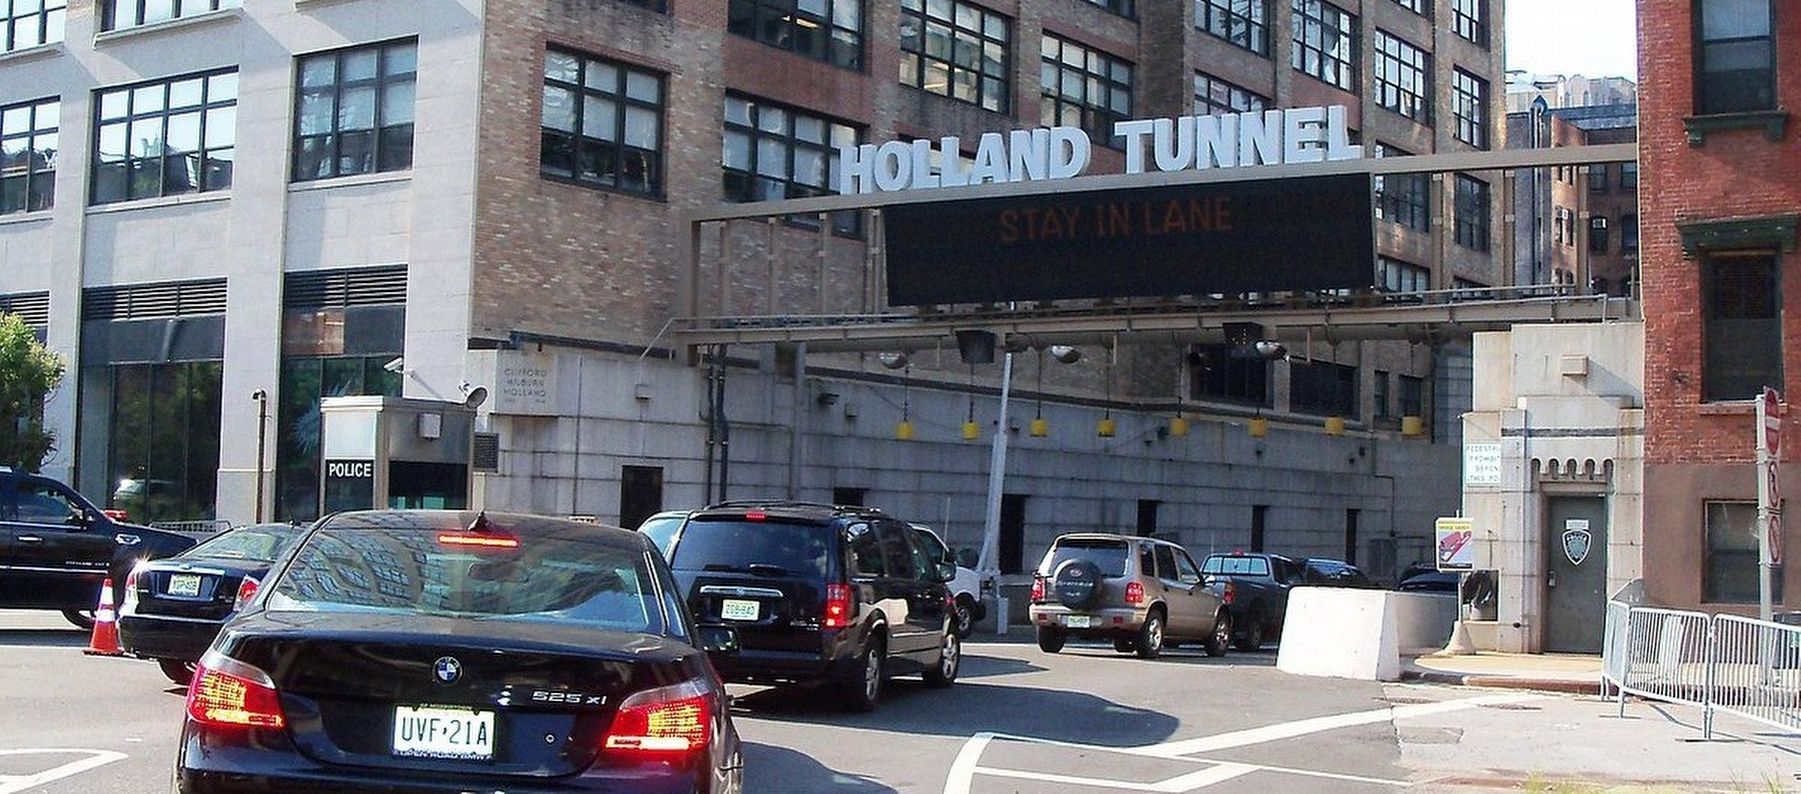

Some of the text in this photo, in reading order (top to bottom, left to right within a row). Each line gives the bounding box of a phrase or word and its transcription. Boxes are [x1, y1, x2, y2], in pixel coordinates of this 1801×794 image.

[839, 104, 1363, 196] HOLLAND TUNNEL
[1000, 196, 1234, 243] STAY IN LANE
[329, 462, 372, 478] POLICE
[531, 690, 583, 703] 525
